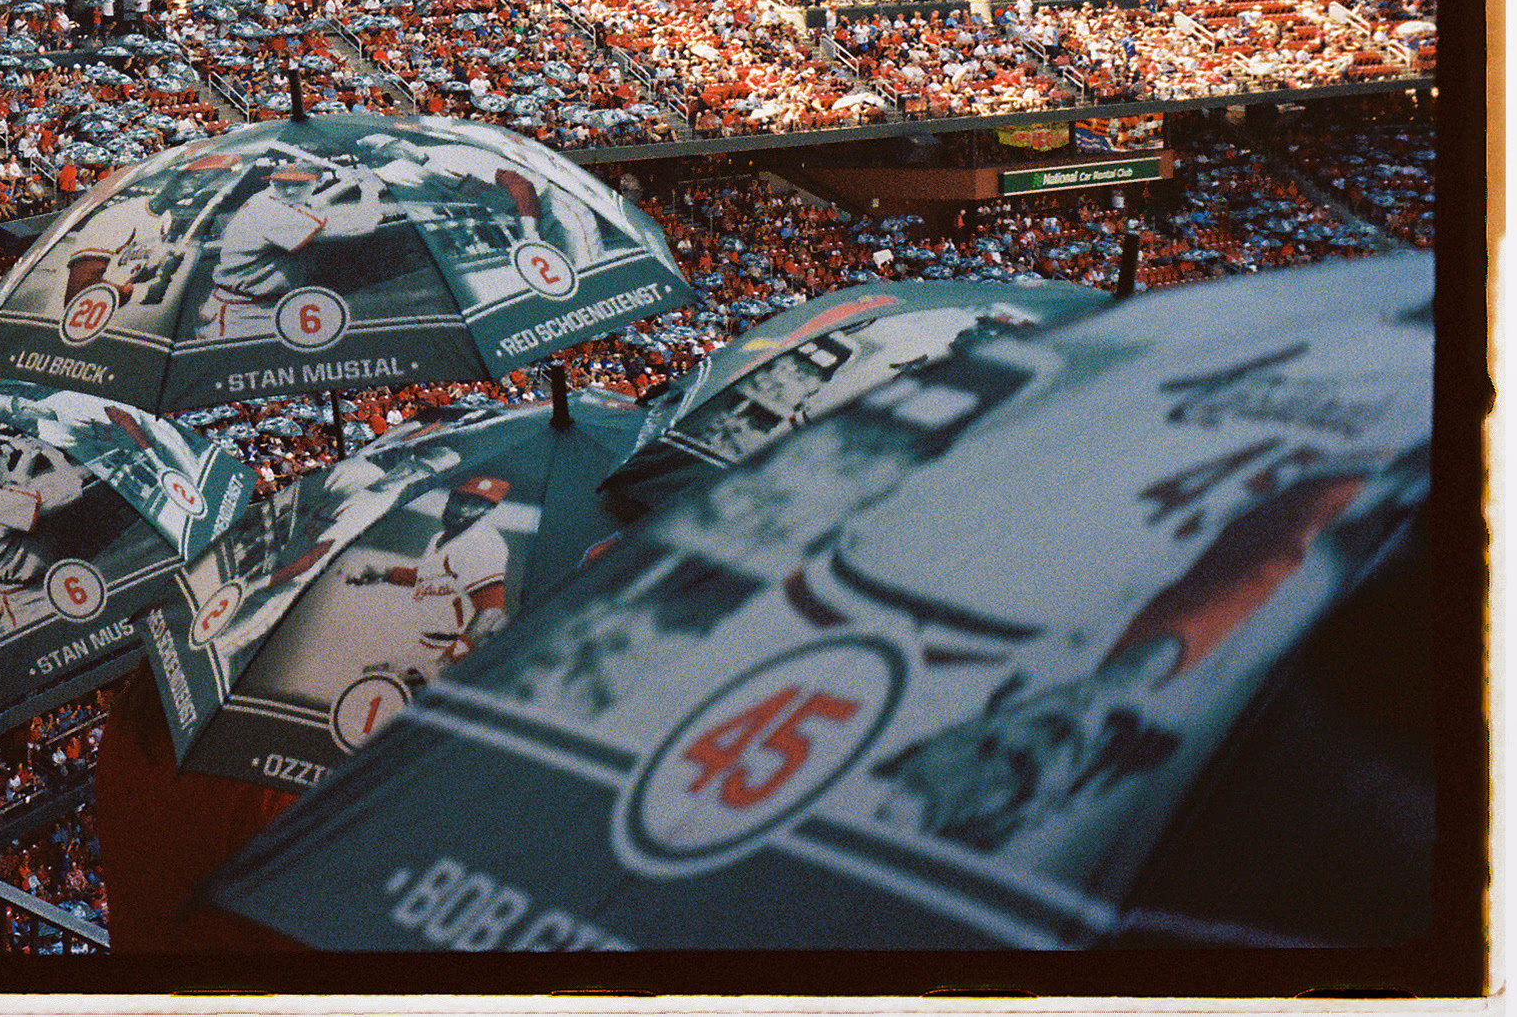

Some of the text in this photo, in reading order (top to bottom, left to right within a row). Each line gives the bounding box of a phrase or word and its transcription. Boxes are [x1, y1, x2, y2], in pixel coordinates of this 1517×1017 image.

[1043, 167, 1134, 186] National Car Rental Club
[531, 255, 561, 285] 2
[68, 299, 108, 330] 20
[299, 304, 322, 334] 6
[499, 283, 663, 357] RED SCHOENDIENST
[15, 350, 109, 384] LOU BROCK
[227, 357, 405, 392] STAN MUSIAL
[172, 482, 195, 505] 2
[64, 575, 88, 606] 6
[202, 599, 229, 631] 2
[36, 637, 90, 675] STAN
[362, 695, 382, 735] 1
[681, 685, 862, 811] 45
[390, 858, 532, 952] BOB
